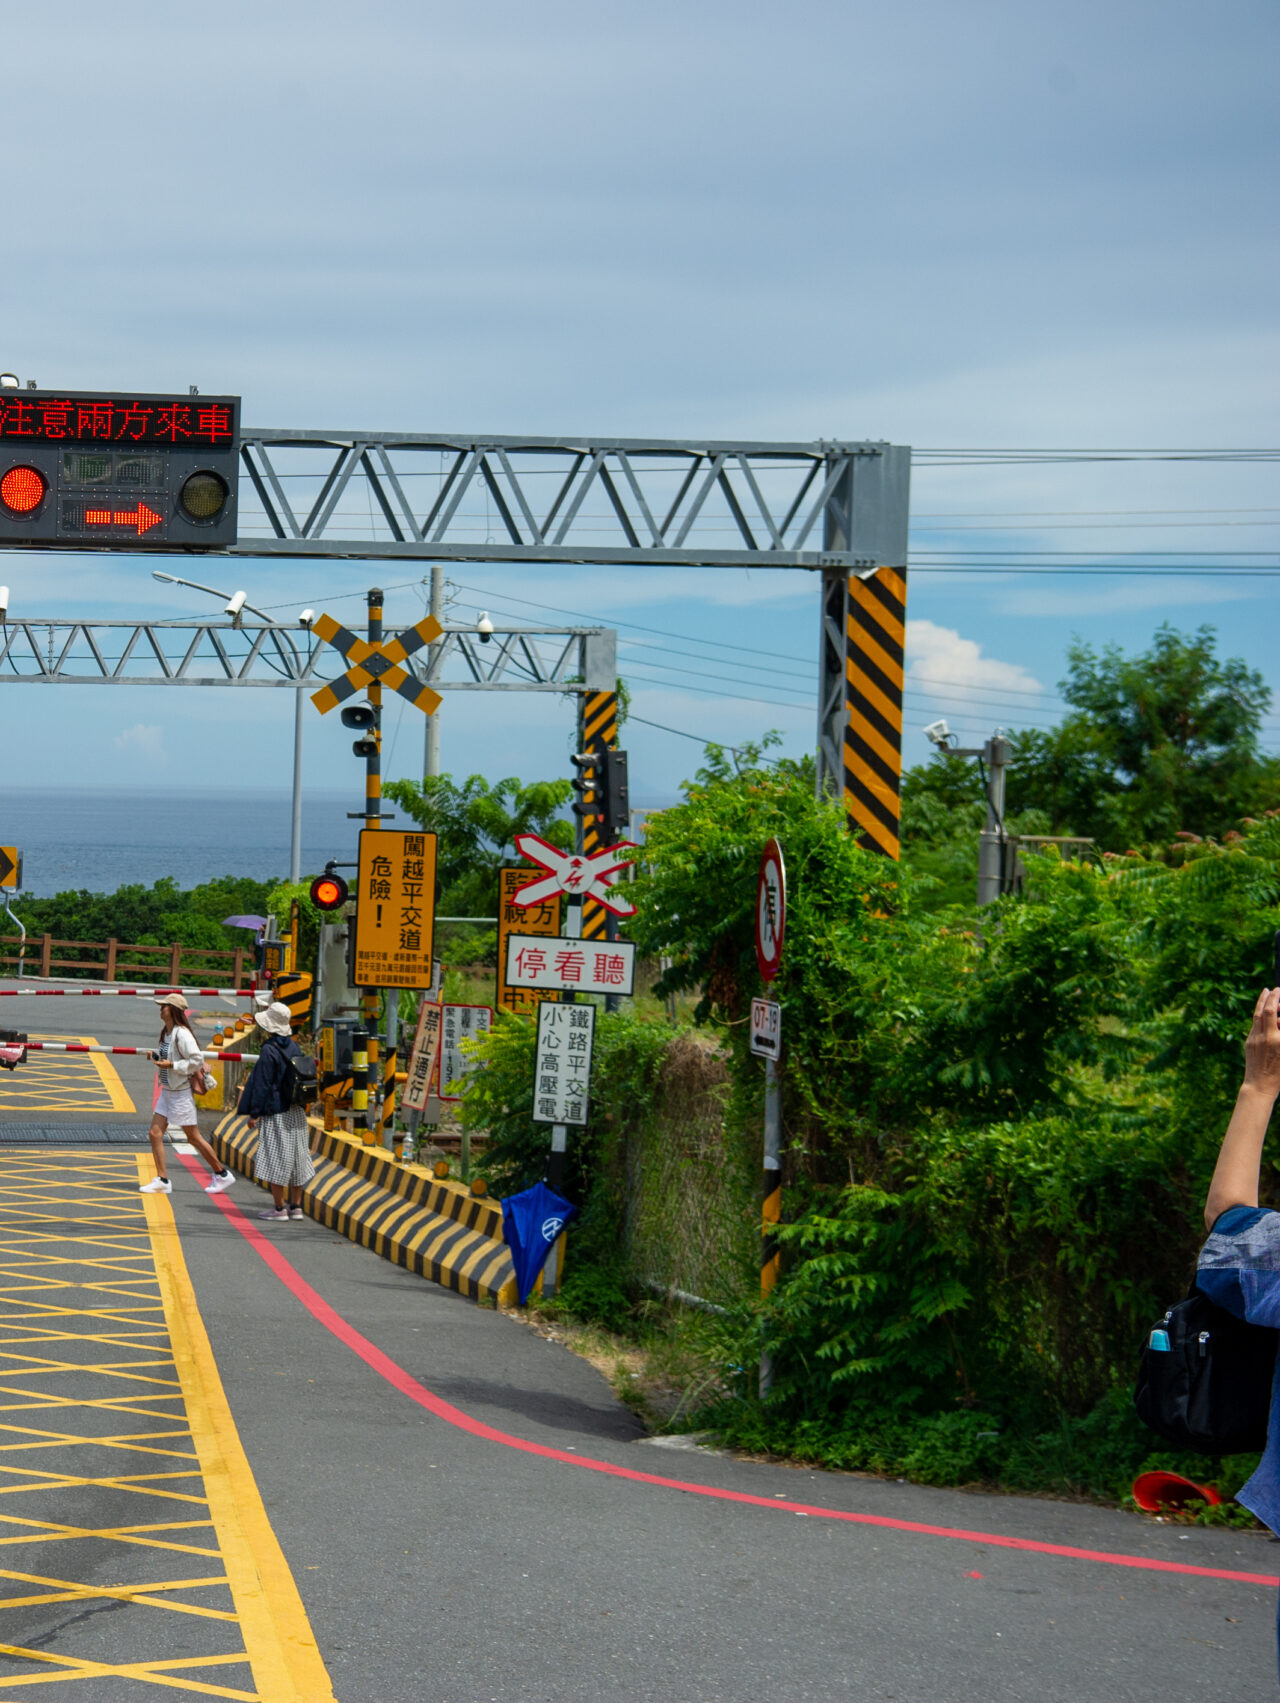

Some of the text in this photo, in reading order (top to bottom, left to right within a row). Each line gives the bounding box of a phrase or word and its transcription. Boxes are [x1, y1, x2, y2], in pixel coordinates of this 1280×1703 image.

[399, 835, 426, 951] 闖越平交道
[514, 946, 626, 985] 停看聽
[409, 1009, 440, 1102] 禁止通行
[538, 1006, 563, 1119] 小心高壓電
[563, 1008, 590, 1122] 鐵路平交道
